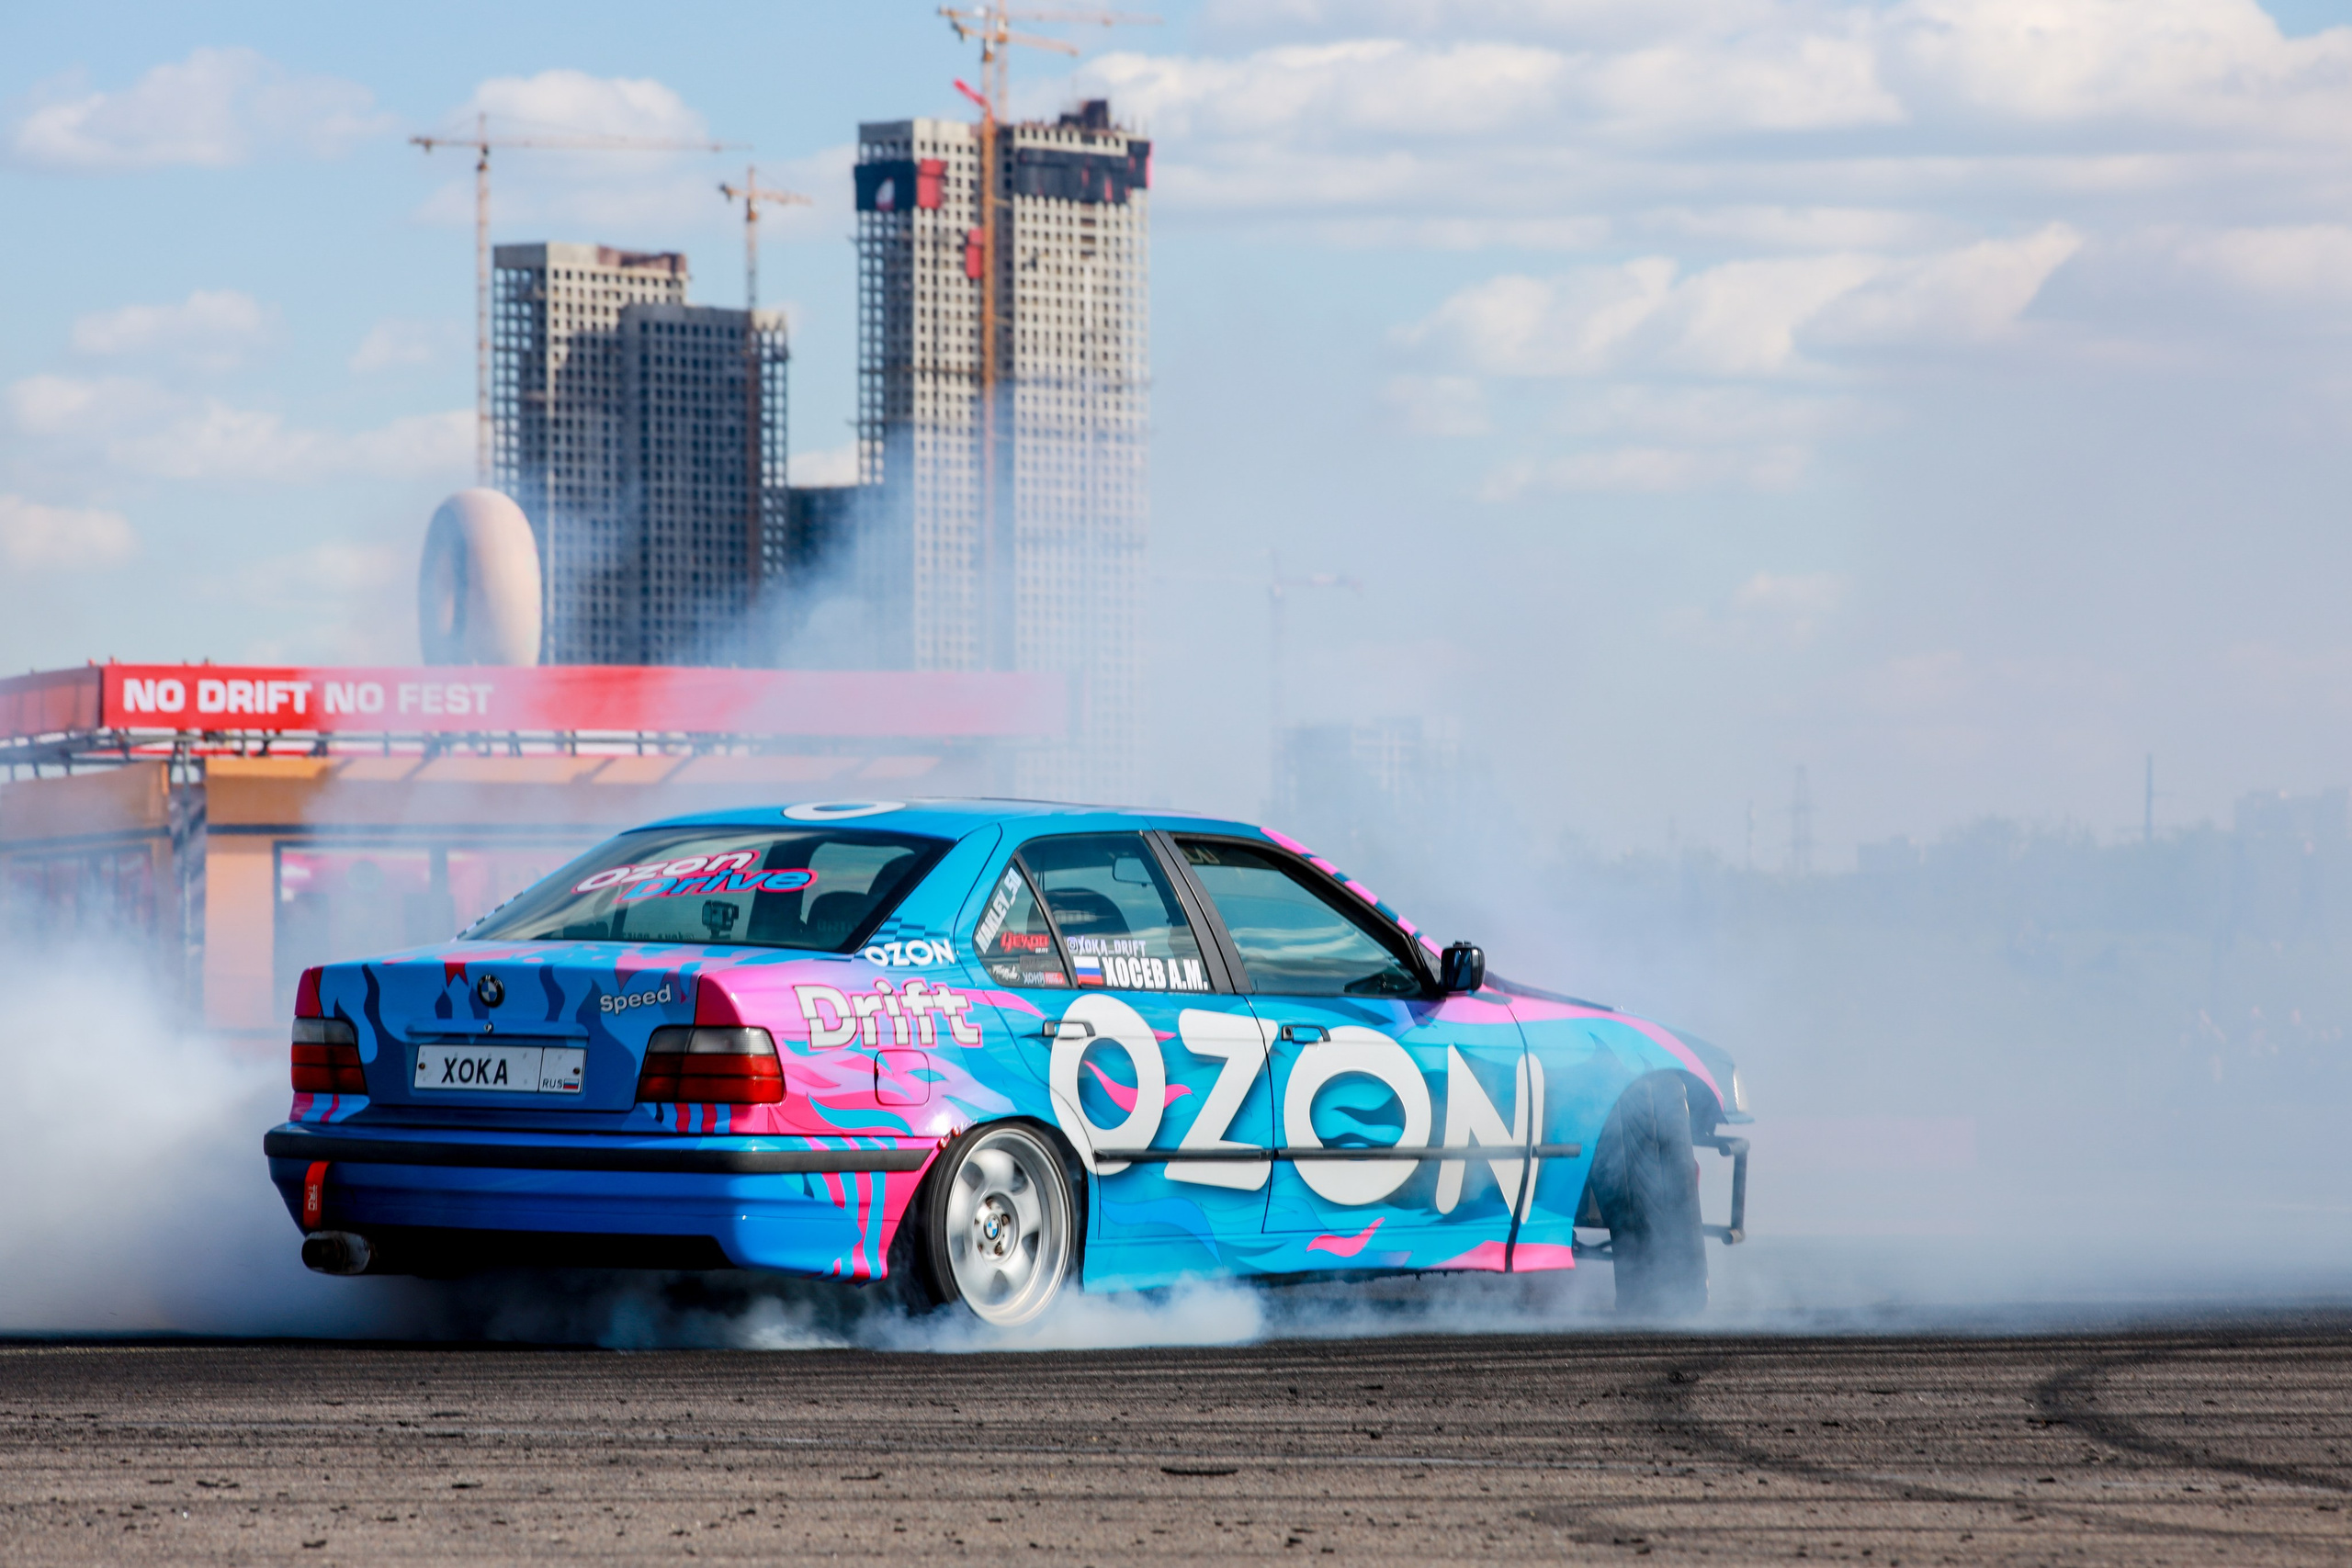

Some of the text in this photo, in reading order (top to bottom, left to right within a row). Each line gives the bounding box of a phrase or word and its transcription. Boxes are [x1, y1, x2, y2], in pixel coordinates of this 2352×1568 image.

[123, 678, 494, 714] NO DRIFT NO FEST
[619, 869, 811, 901] Drive
[865, 939, 956, 966] OZON
[1102, 956, 1167, 989] ХОСЕВ
[600, 985, 672, 1015] Speed
[793, 980, 980, 1048] Drift
[542, 1077, 563, 1089] RUS
[1049, 993, 1545, 1224] OZON
